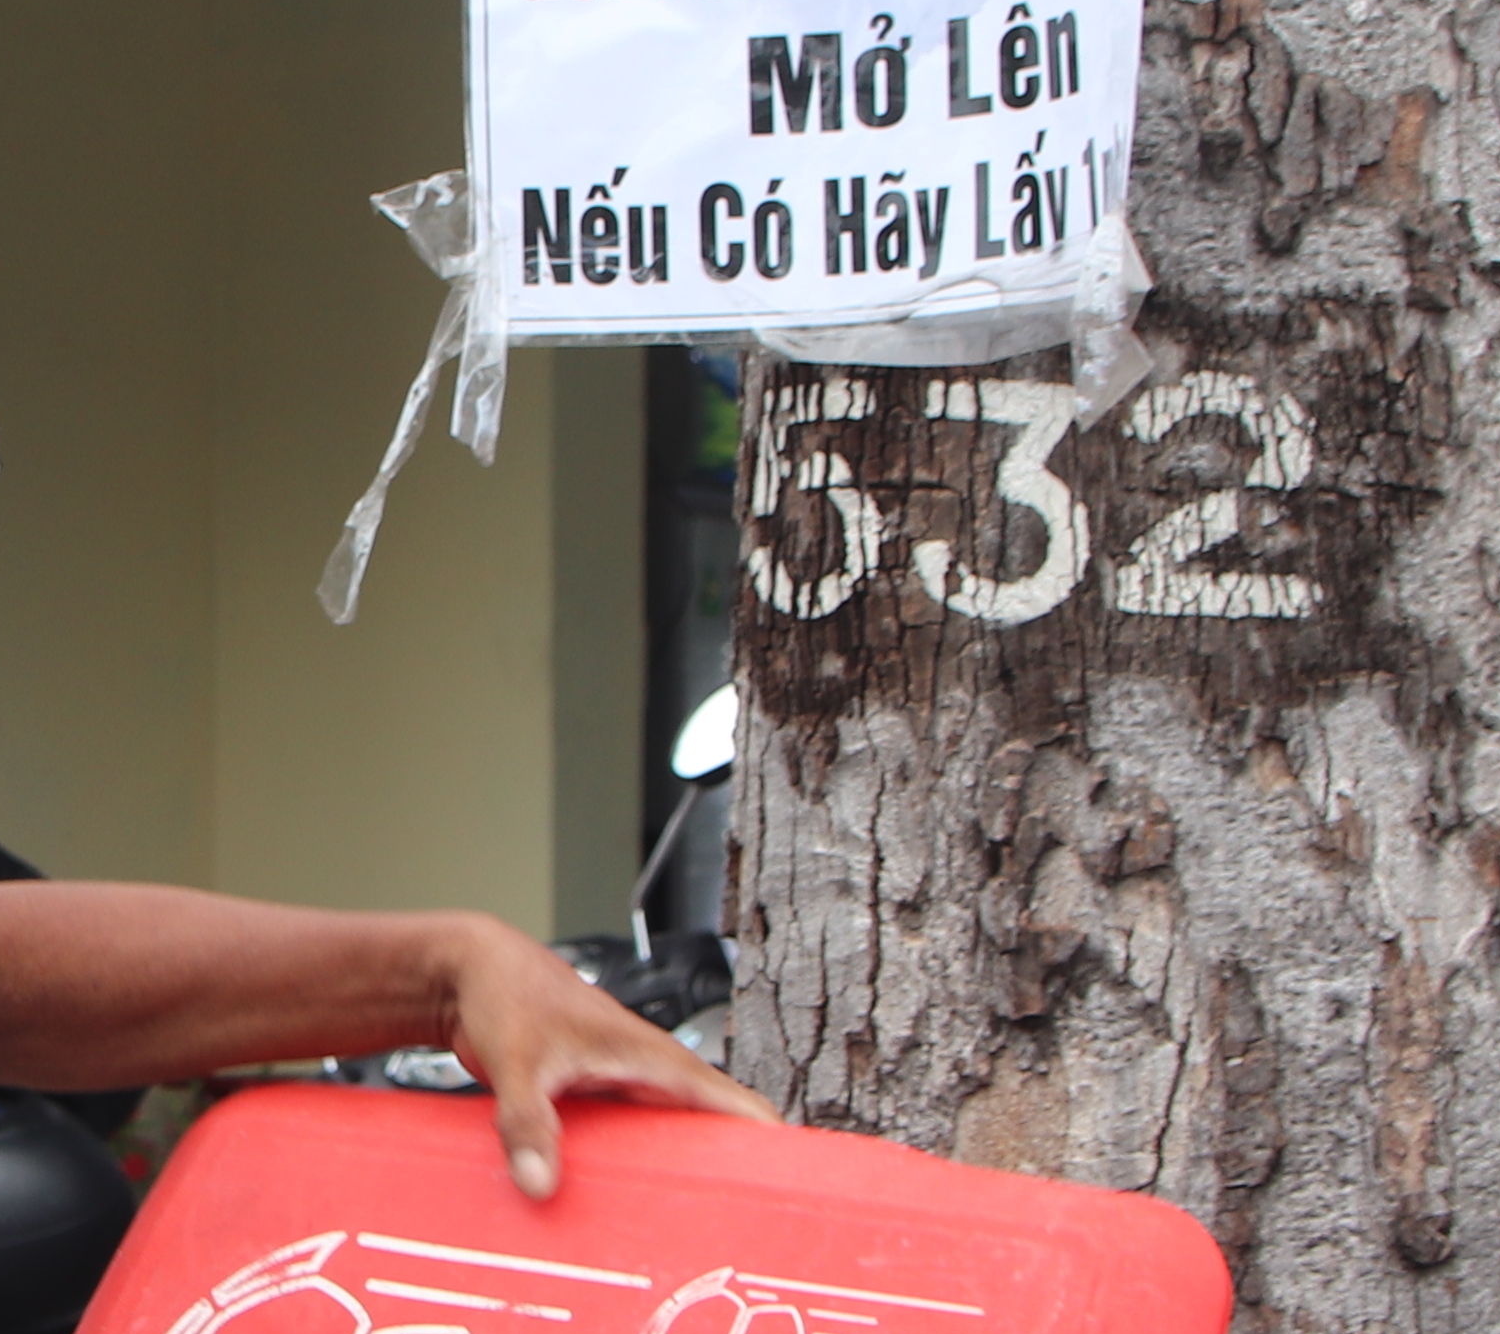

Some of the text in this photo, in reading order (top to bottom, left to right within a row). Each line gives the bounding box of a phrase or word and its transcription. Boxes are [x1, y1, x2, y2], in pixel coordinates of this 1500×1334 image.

[748, 1, 1081, 136] Mở Lên
[521, 165, 669, 286] Nếu
[699, 176, 793, 282] Có
[823, 168, 951, 282] Hãy
[974, 130, 1068, 262] Lấy
[748, 371, 1323, 624] 532
